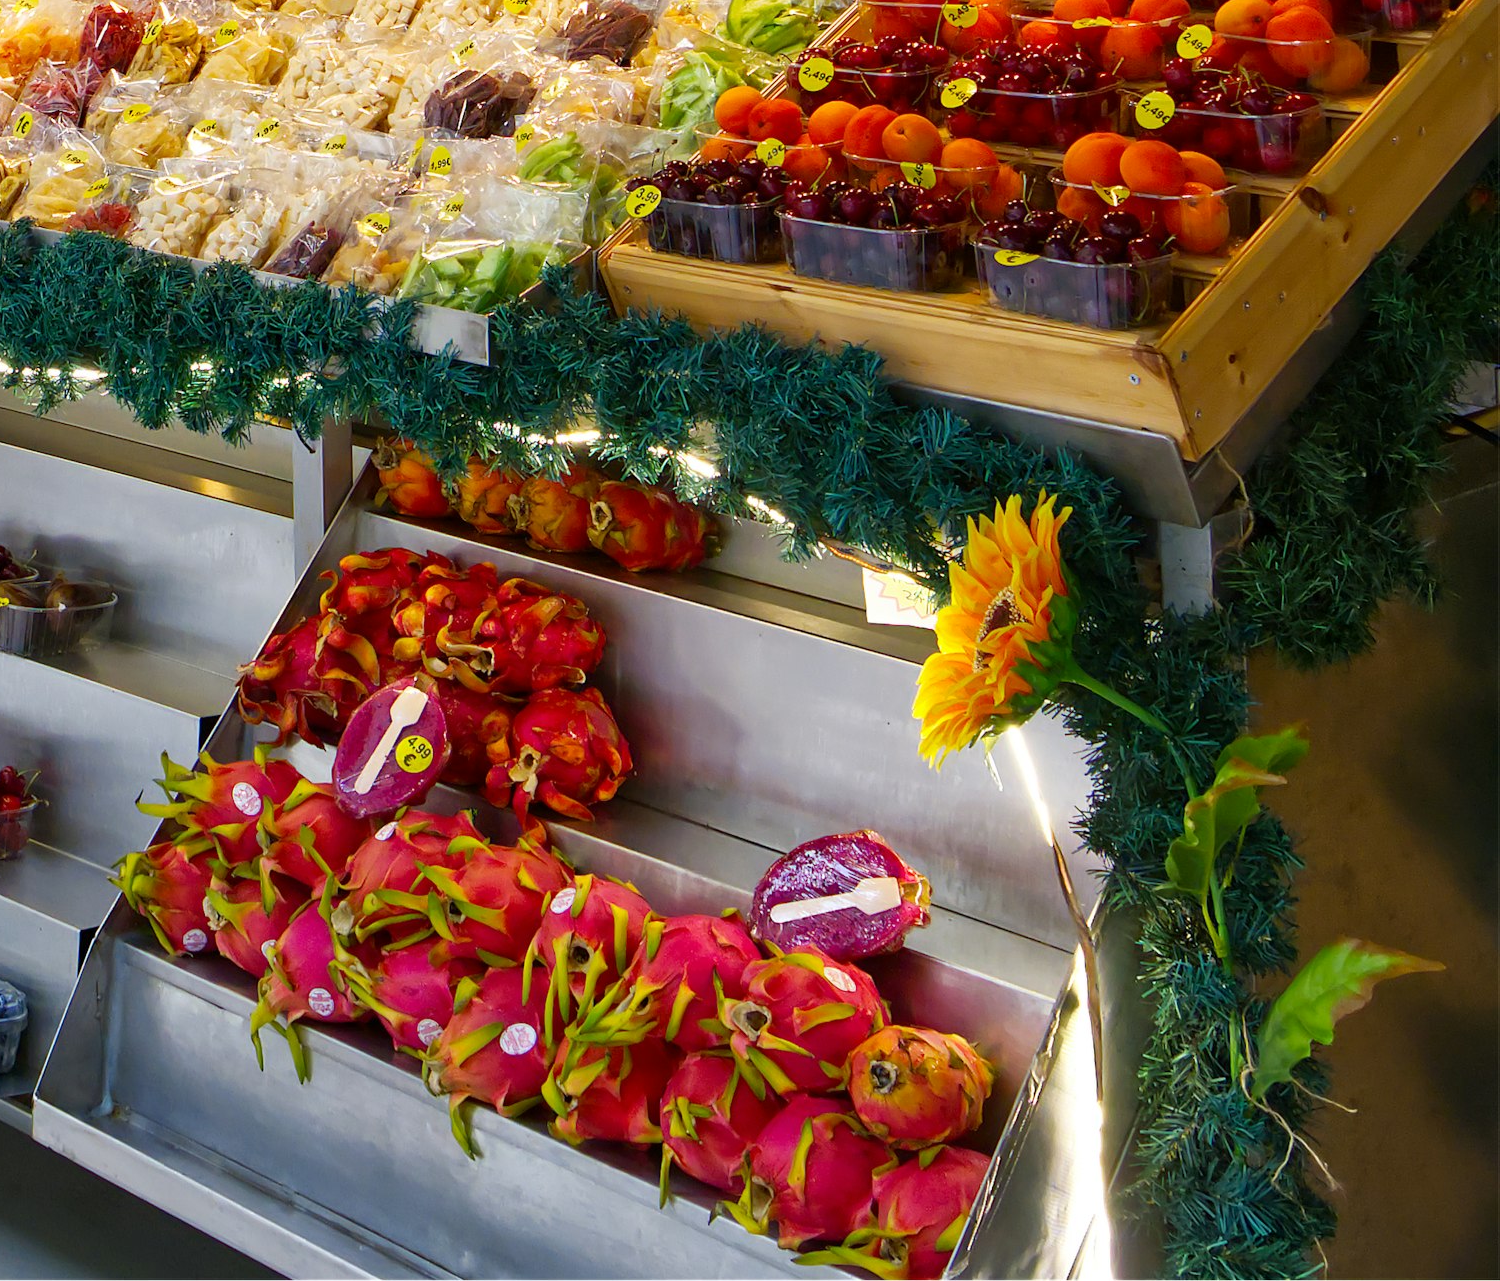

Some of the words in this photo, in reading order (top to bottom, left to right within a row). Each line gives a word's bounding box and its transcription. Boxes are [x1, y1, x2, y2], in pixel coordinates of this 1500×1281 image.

[1183, 32, 1209, 54] 2,49€
[803, 66, 834, 84] 2,49€
[1141, 100, 1170, 125] 2,49€
[15, 118, 29, 134] 1€
[254, 121, 281, 139] 1,99€
[431, 156, 451, 170] 1,99€
[634, 188, 660, 203] 3.99
[633, 203, 646, 216] €
[407, 735, 432, 761] 4.99
[403, 753, 417, 768] €
